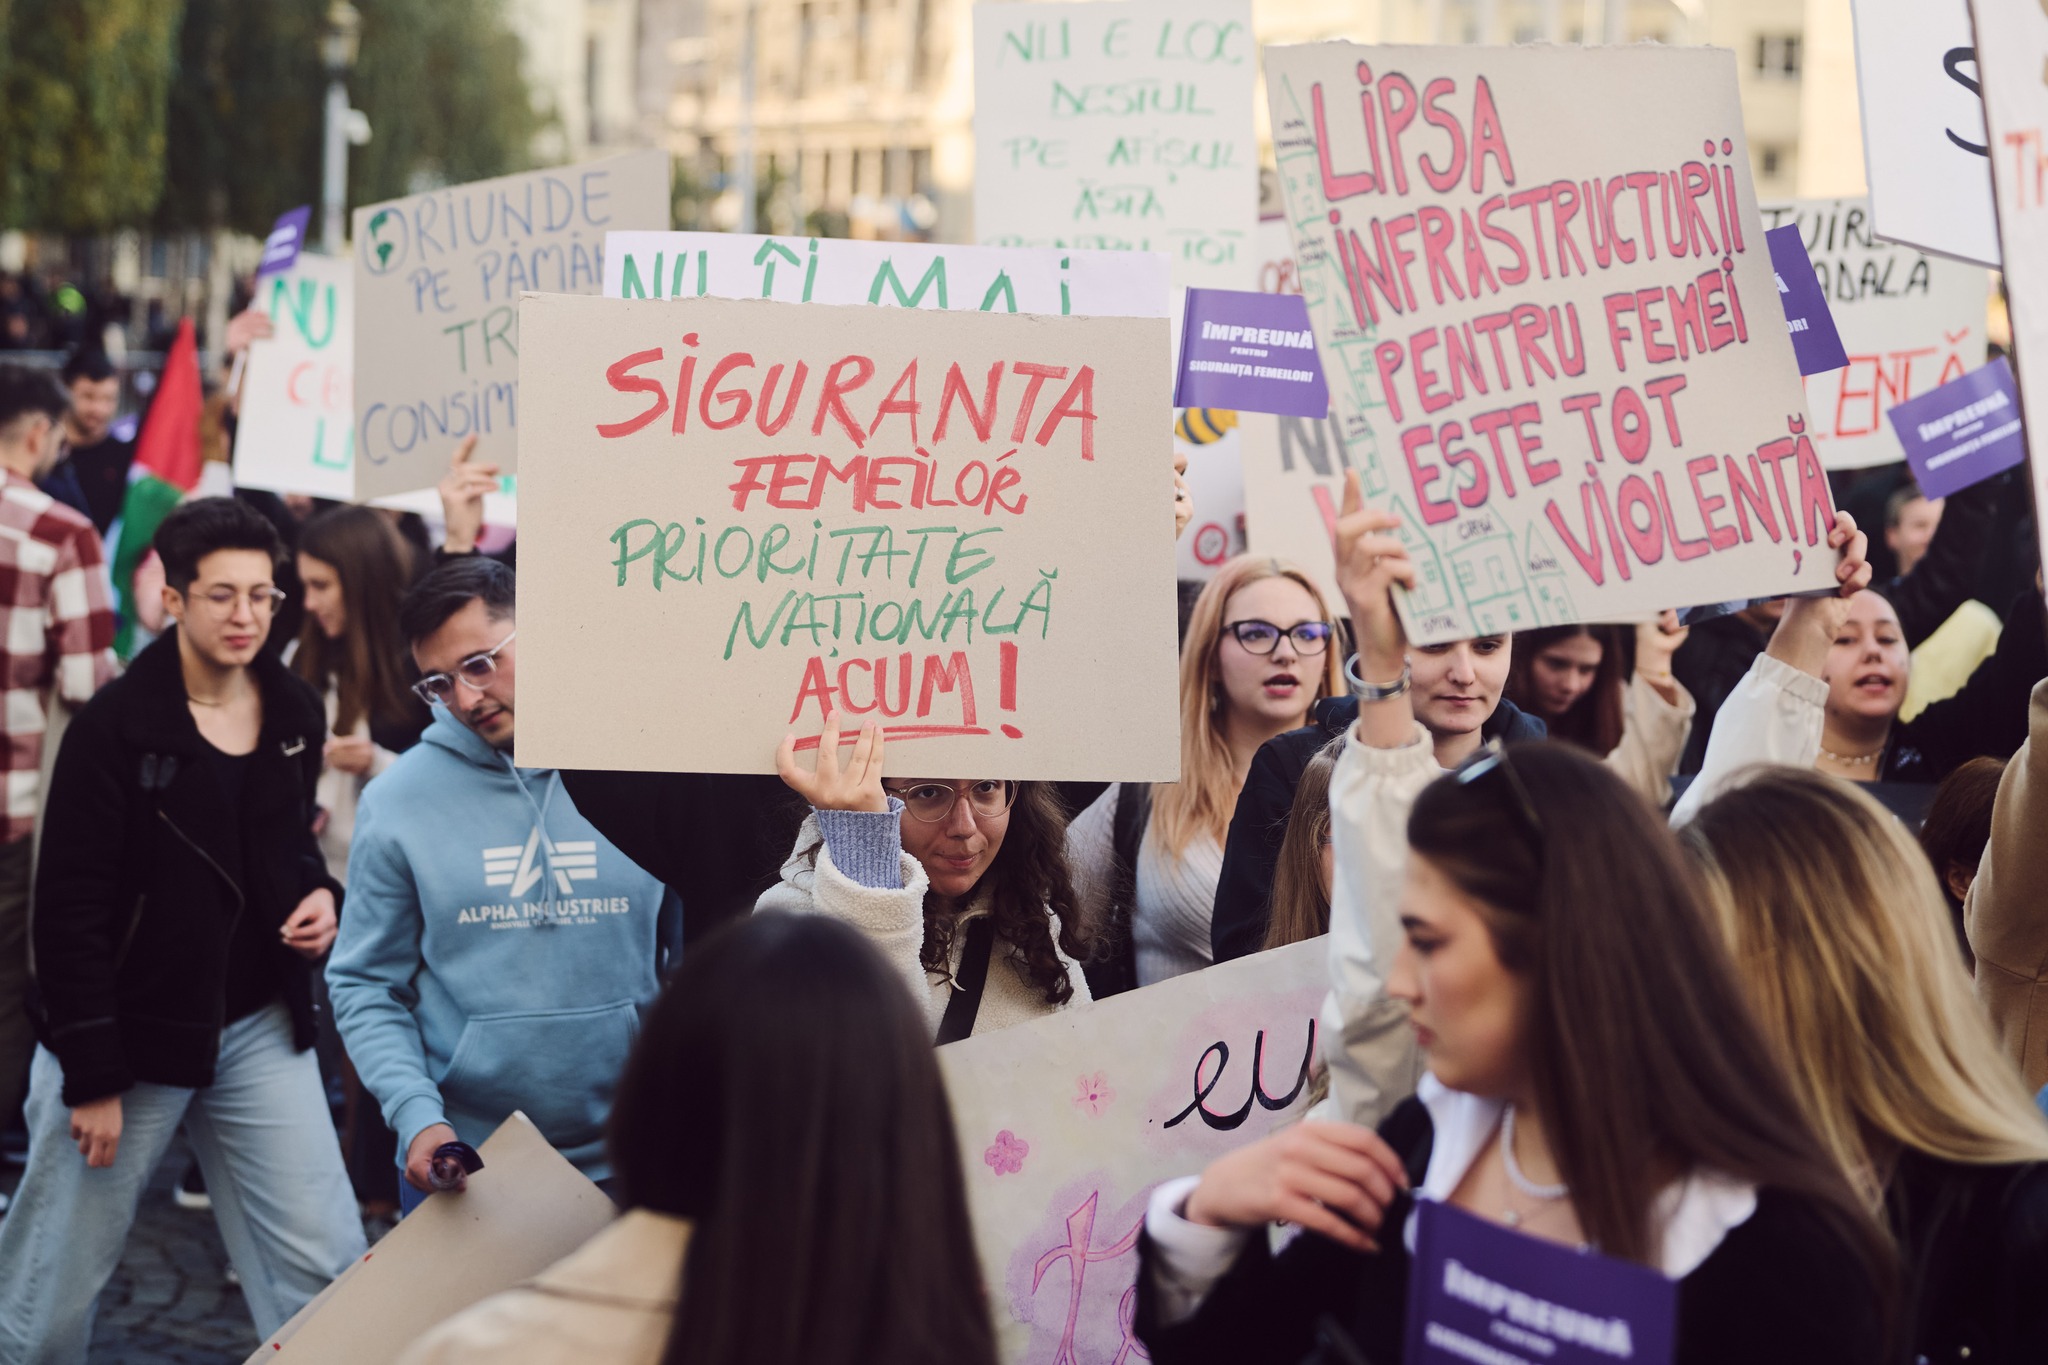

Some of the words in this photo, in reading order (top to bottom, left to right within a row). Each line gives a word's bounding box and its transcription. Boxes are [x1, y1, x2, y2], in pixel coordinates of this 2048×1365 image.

[1311, 59, 1516, 202] LIPSA
[1328, 137, 1747, 330] INFRASTRUCTURII
[408, 265, 457, 315] PE
[1201, 320, 1314, 350] ÎMPREUNĂ
[1373, 301, 1586, 426] PENTRU
[1602, 256, 1749, 373] FEMEI
[596, 331, 1100, 461] SIGURANTA
[1188, 359, 1252, 379] SIGURANȚA
[728, 447, 1028, 515] FEMEILOR
[1401, 402, 1563, 526] ESTE
[1561, 374, 1687, 465] TOT
[1544, 412, 1837, 587] VIOLENȚĂ
[609, 516, 1004, 592] PRIORITATE
[723, 567, 1060, 661] NAȚIONALĂ
[458, 904, 518, 925] ALPHA
[1164, 1017, 1319, 1131] eu
